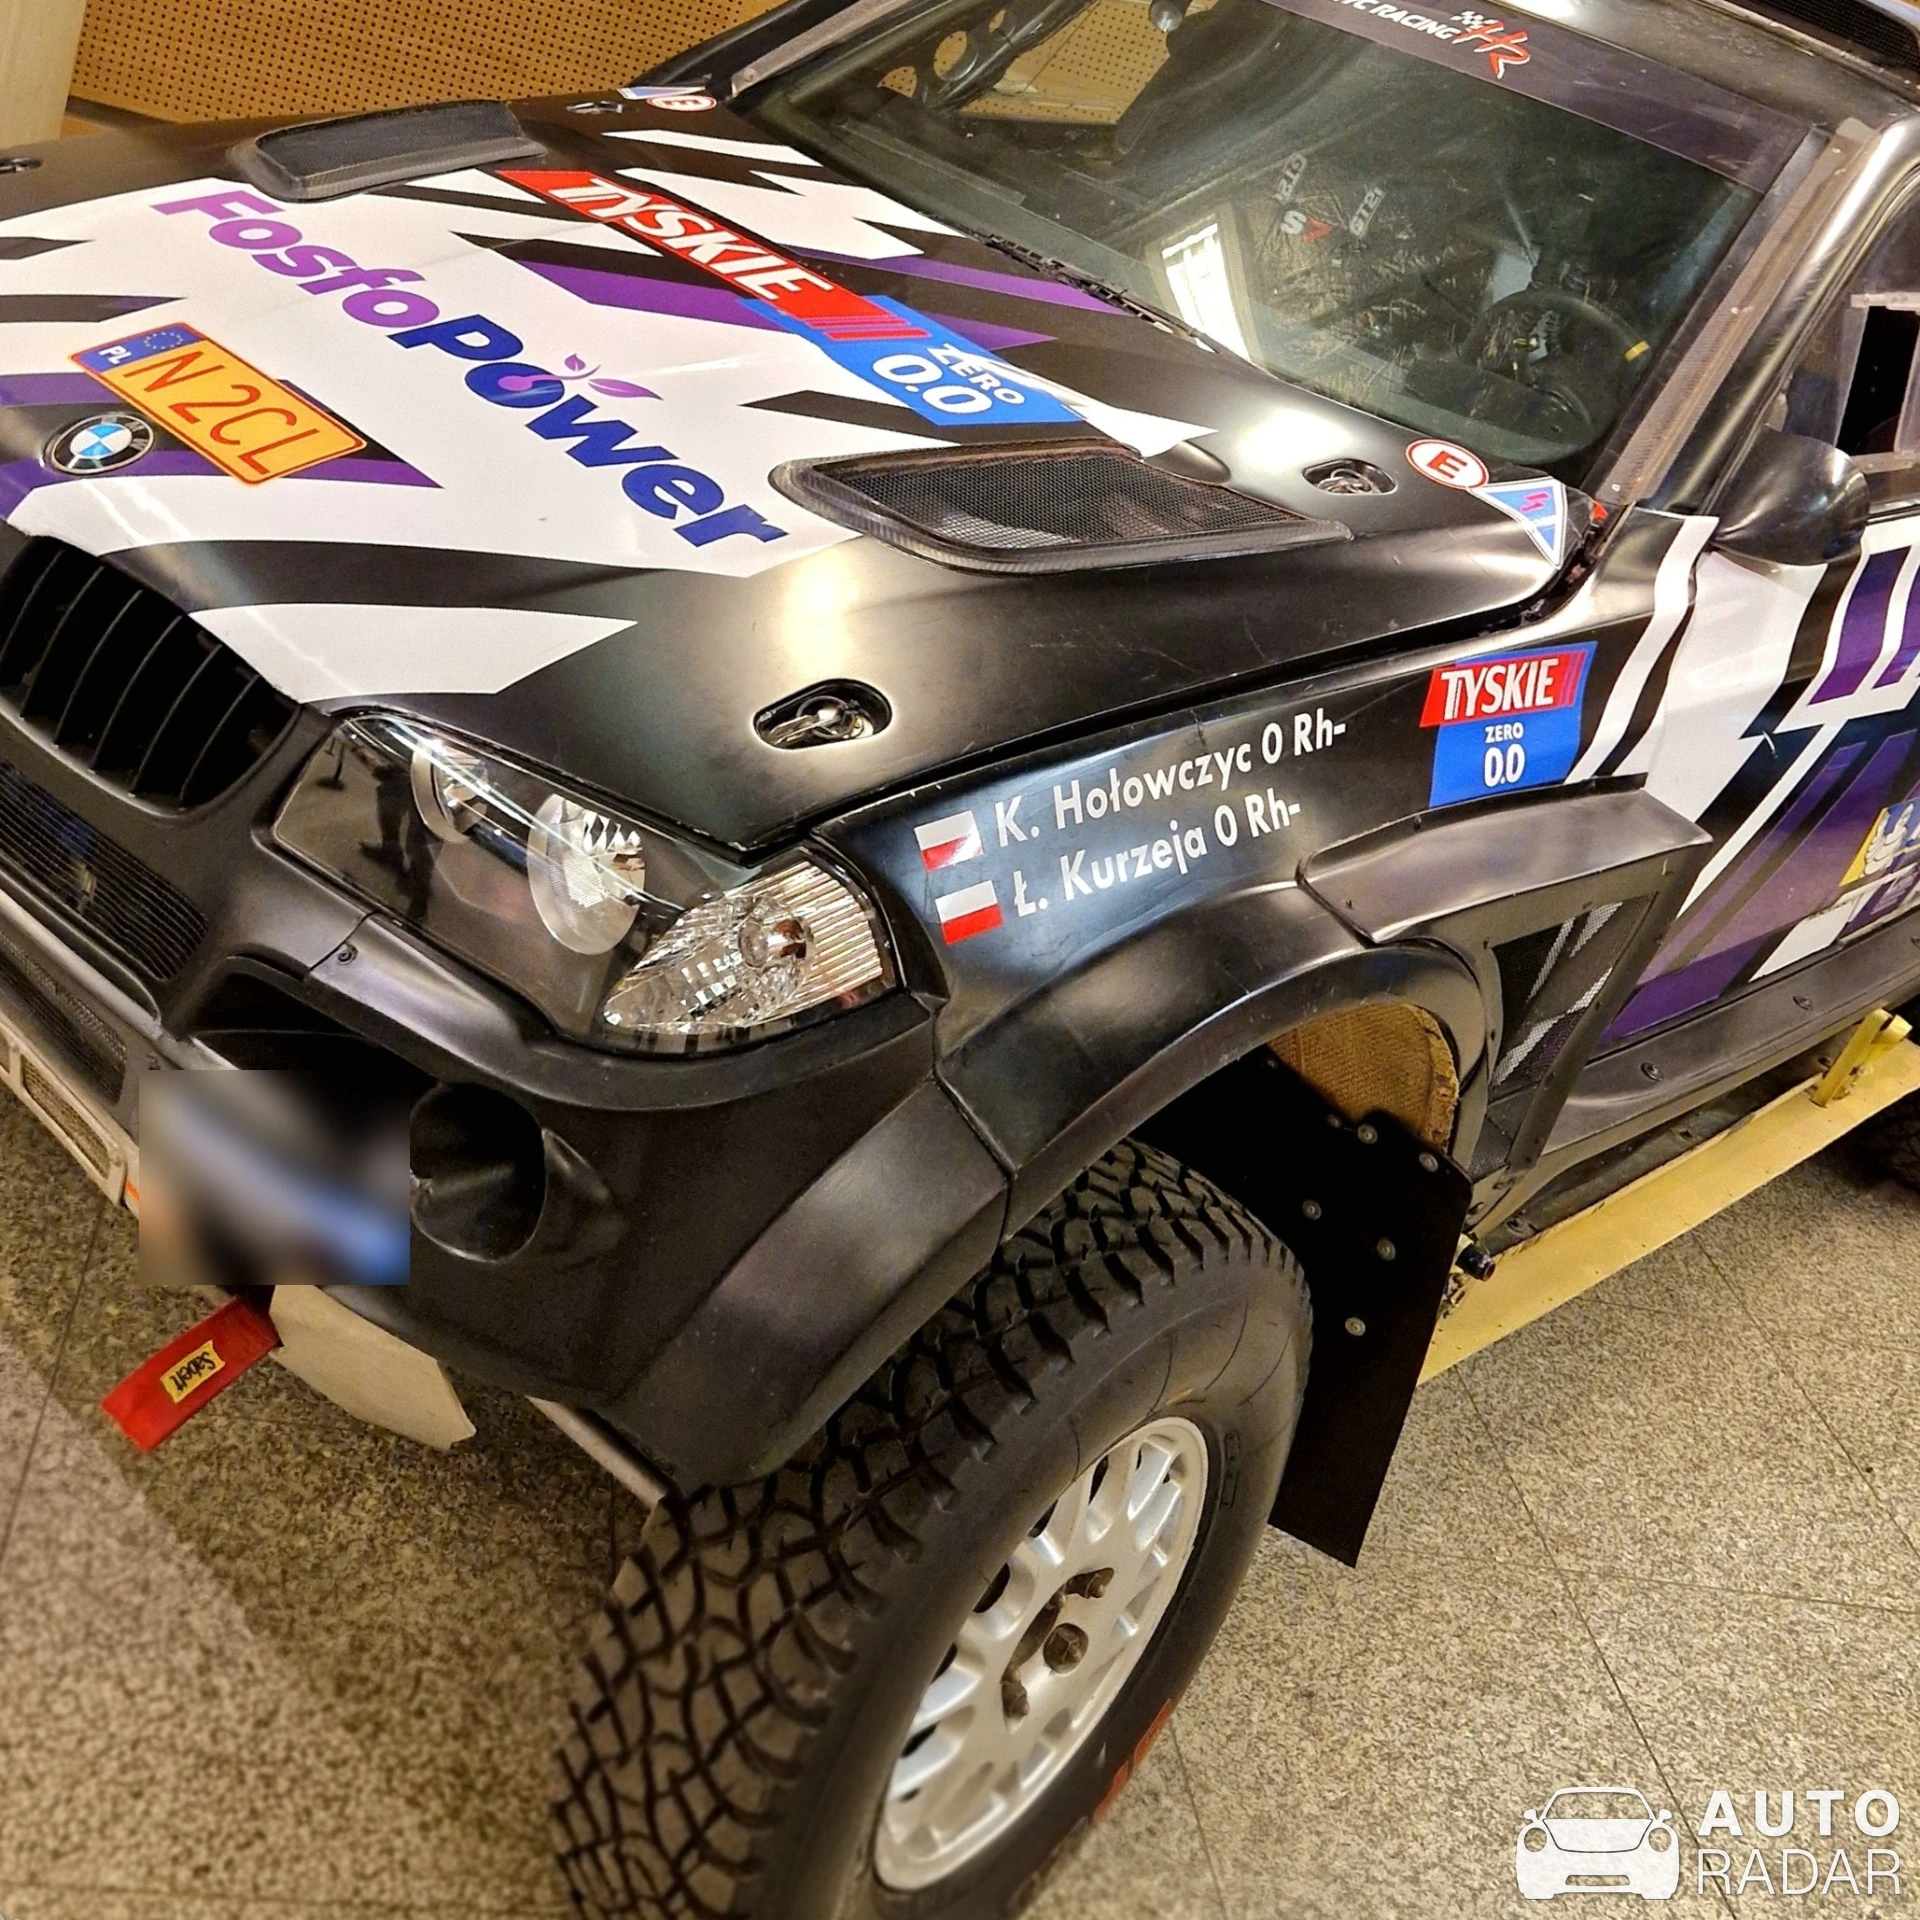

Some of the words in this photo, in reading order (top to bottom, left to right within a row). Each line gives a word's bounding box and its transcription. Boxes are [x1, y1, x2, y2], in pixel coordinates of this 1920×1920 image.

[1370, 4, 1461, 40] RACING
[548, 178, 834, 300] TYSKIE
[99, 345, 131, 365] PL
[927, 343, 1025, 404] ZERO
[873, 354, 992, 413] 0.0
[1426, 450, 1468, 480] E
[1441, 658, 1558, 720] TYSKIE
[1485, 722, 1524, 743] ZERO
[995, 796, 1039, 847] K.
[1053, 743, 1251, 829] Hołowczyc
[1294, 708, 1346, 756] Rh-
[1484, 743, 1526, 787] 0.0
[1013, 870, 1048, 917] Ł.
[1061, 820, 1207, 900] Kurzeja
[1245, 788, 1301, 838] Rh-
[169, 1352, 216, 1391] Sabelt
